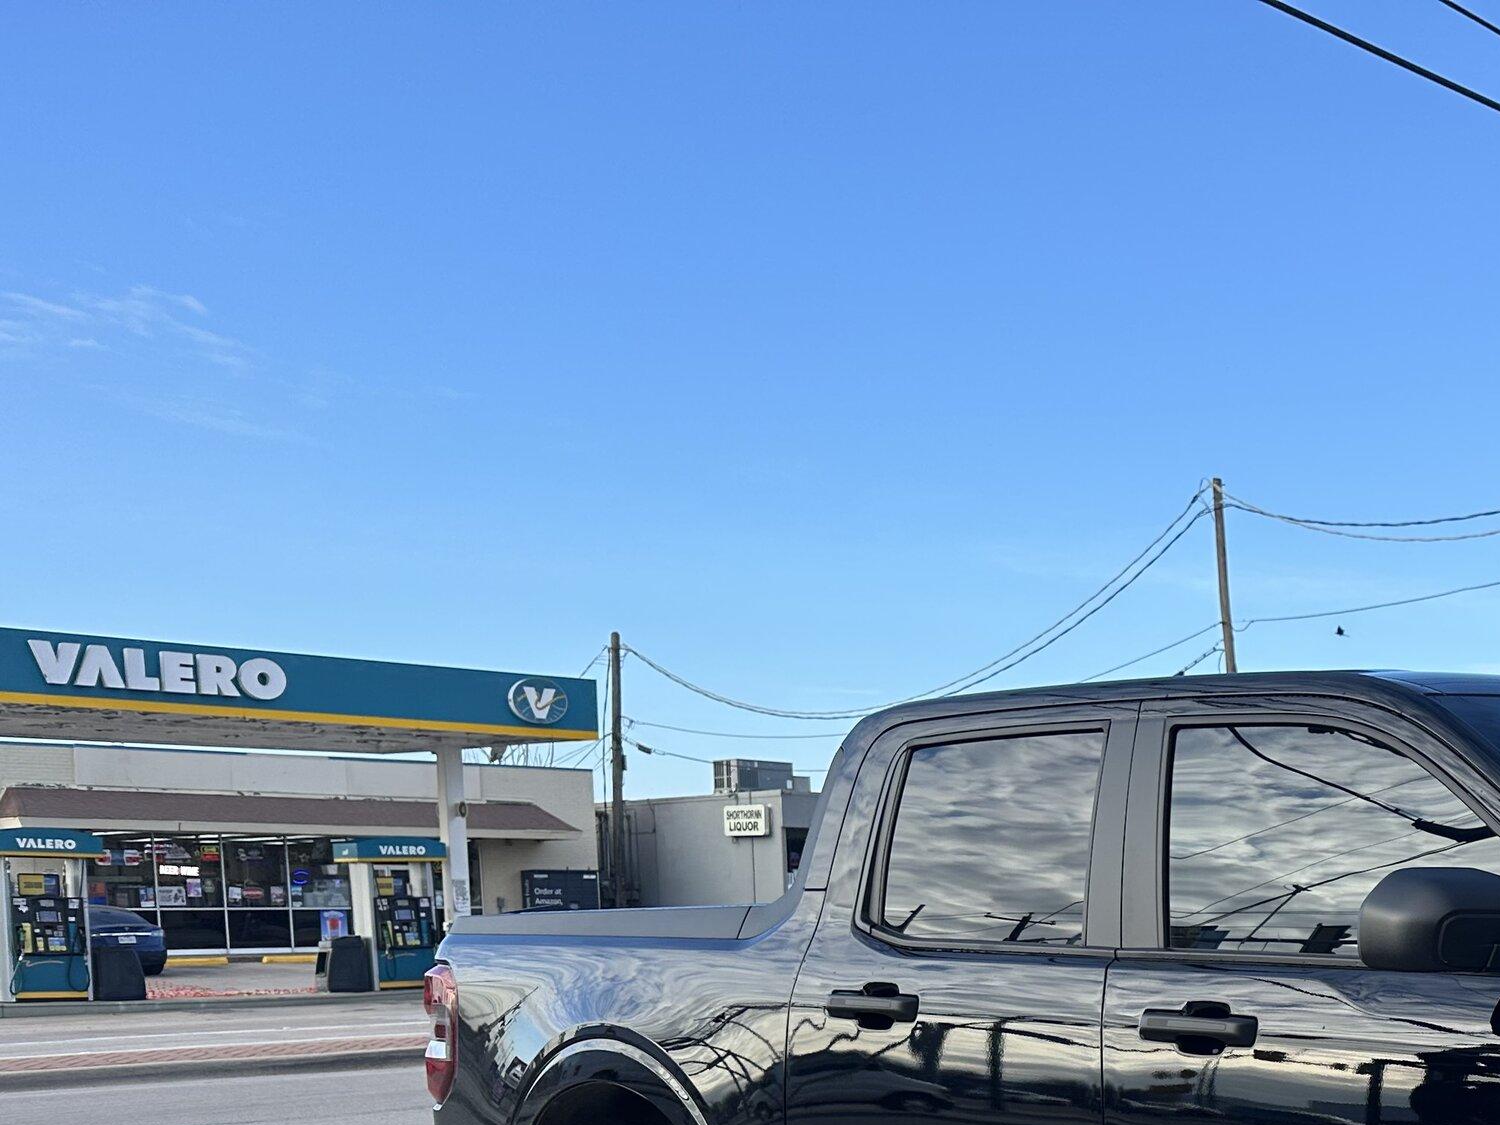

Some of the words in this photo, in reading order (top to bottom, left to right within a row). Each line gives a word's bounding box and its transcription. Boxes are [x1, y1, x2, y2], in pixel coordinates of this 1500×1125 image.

[27, 639, 287, 700] VALERO
[729, 821, 759, 832] LIQUOR
[16, 838, 77, 850] VALERO
[379, 845, 426, 855] VALERO
